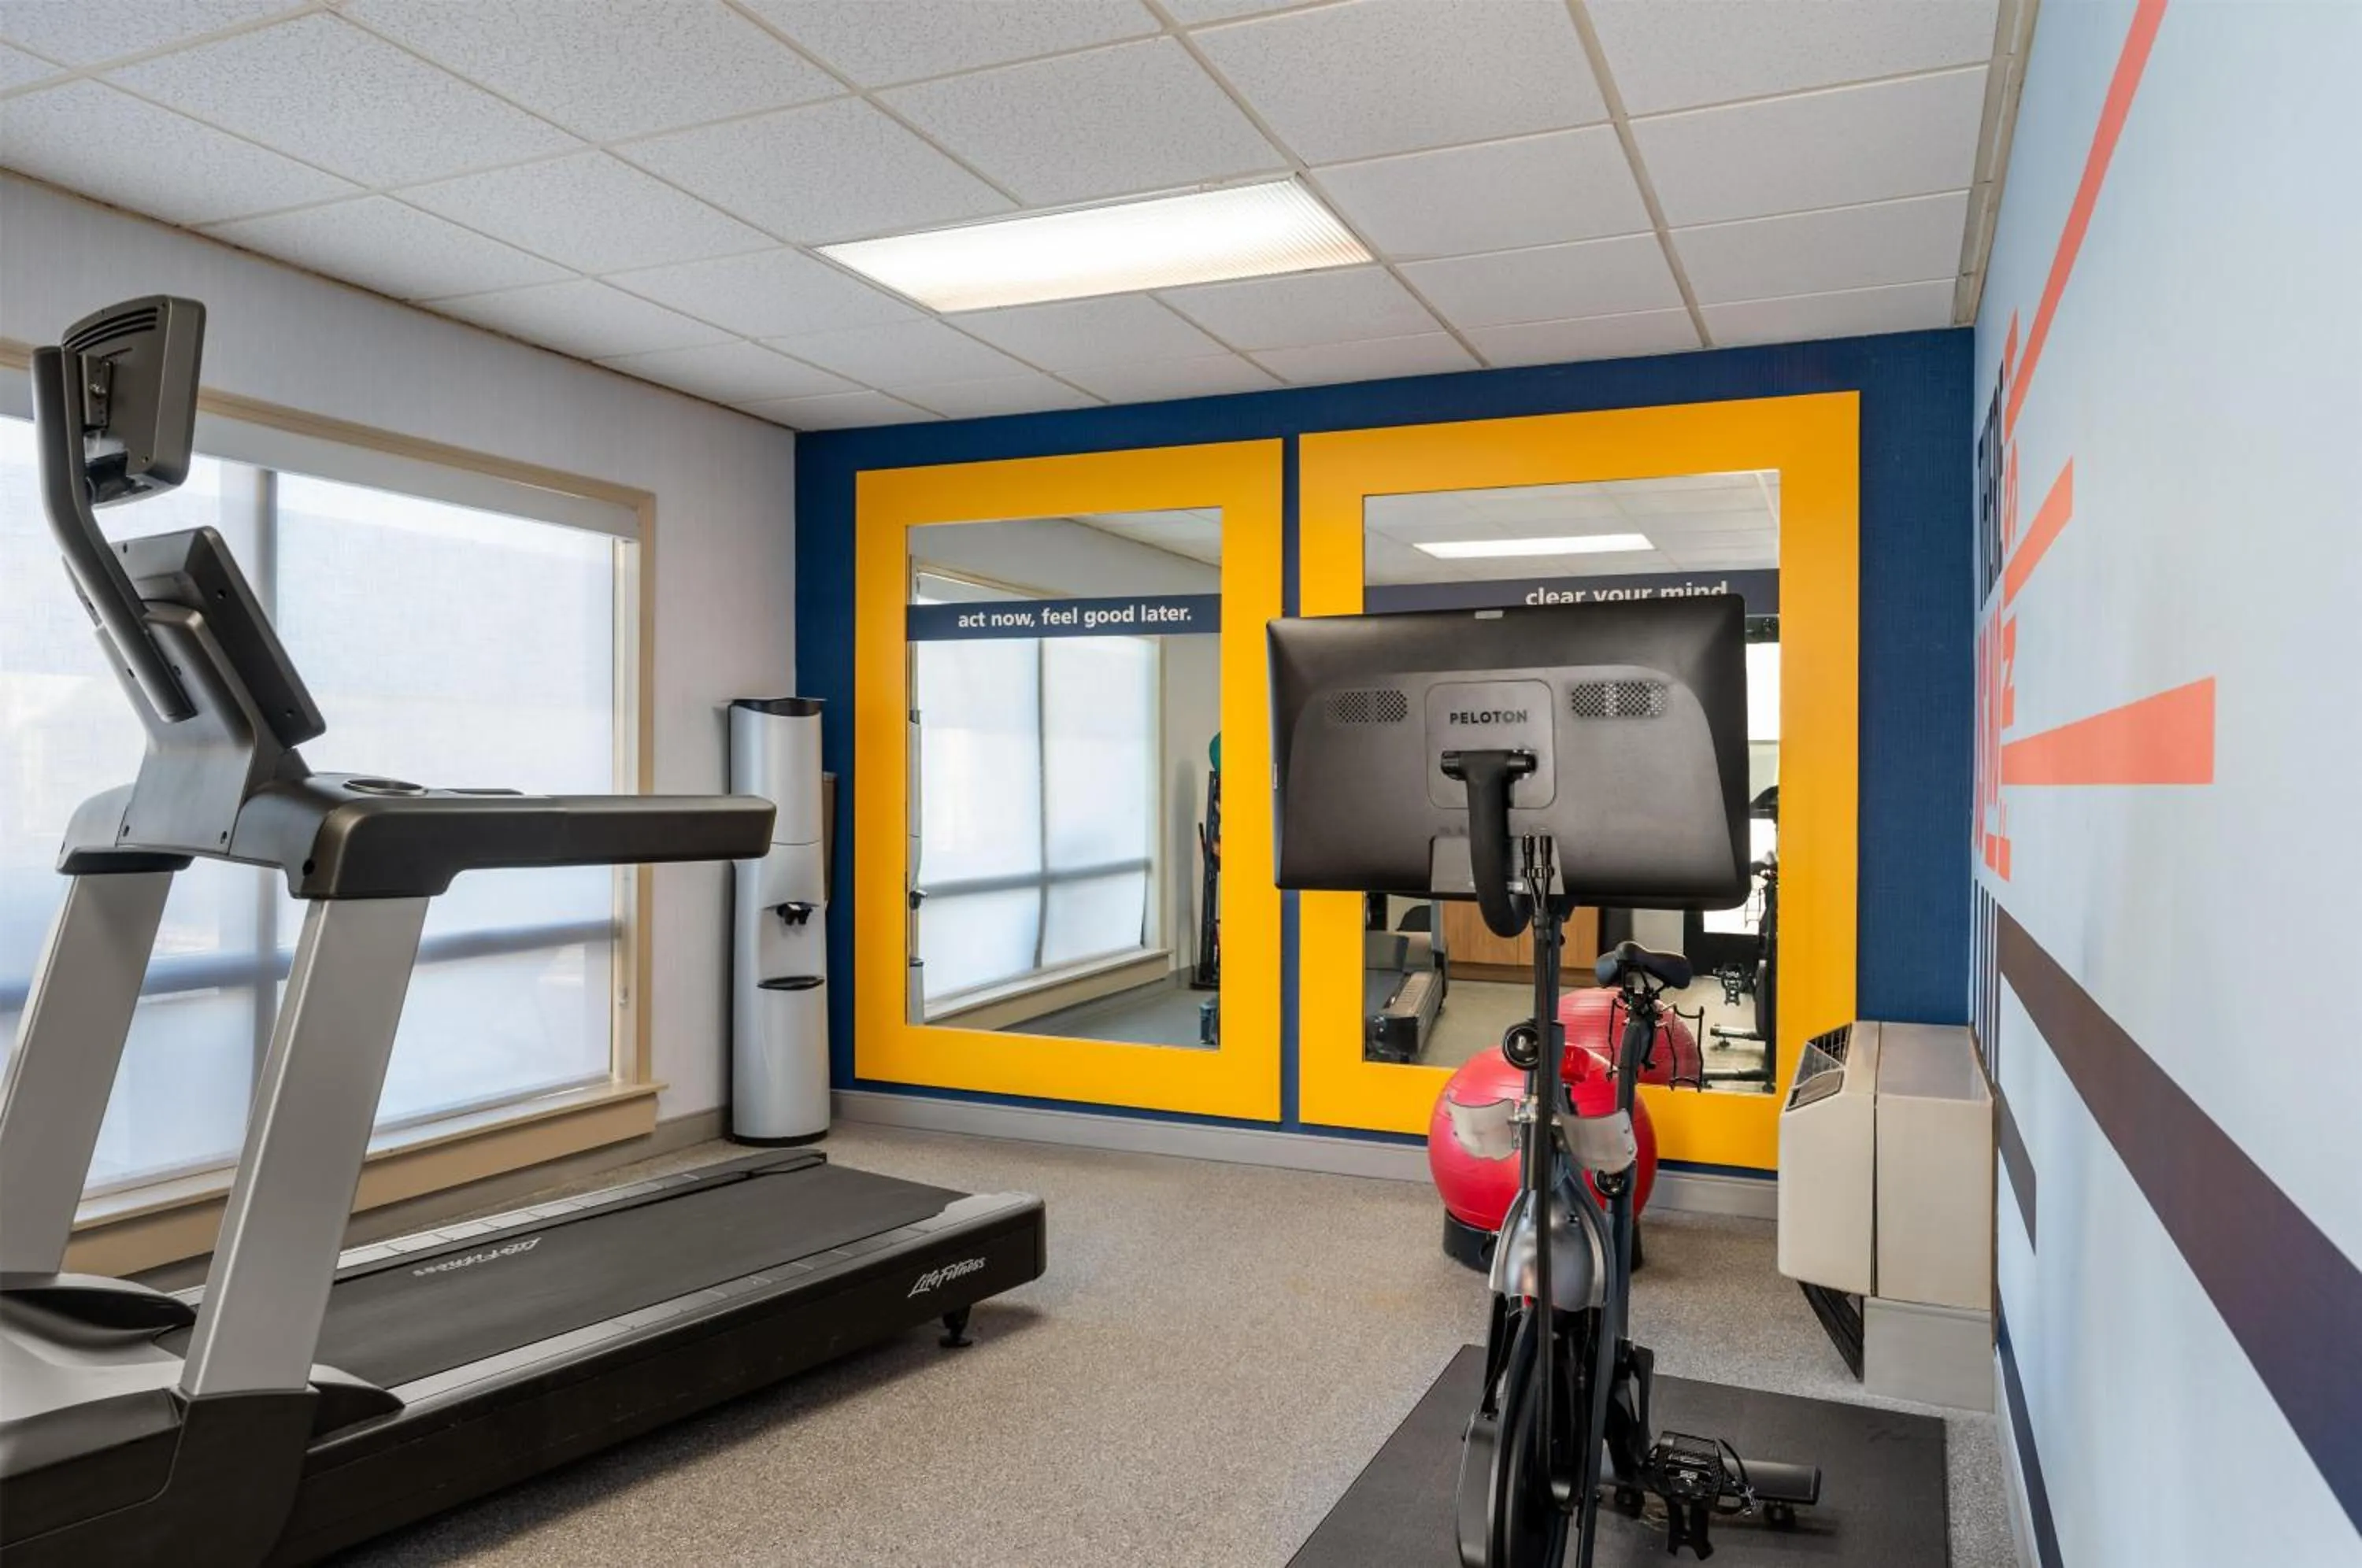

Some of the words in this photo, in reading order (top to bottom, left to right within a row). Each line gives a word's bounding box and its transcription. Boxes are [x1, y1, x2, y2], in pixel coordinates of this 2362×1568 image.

[1525, 587, 1586, 605] clear
[957, 612, 985, 627] act
[990, 612, 1035, 627] now,
[1042, 607, 1078, 625] feel
[1084, 605, 1135, 628] good
[1141, 604, 1192, 622] later.
[1449, 710, 1527, 724] PELOTON
